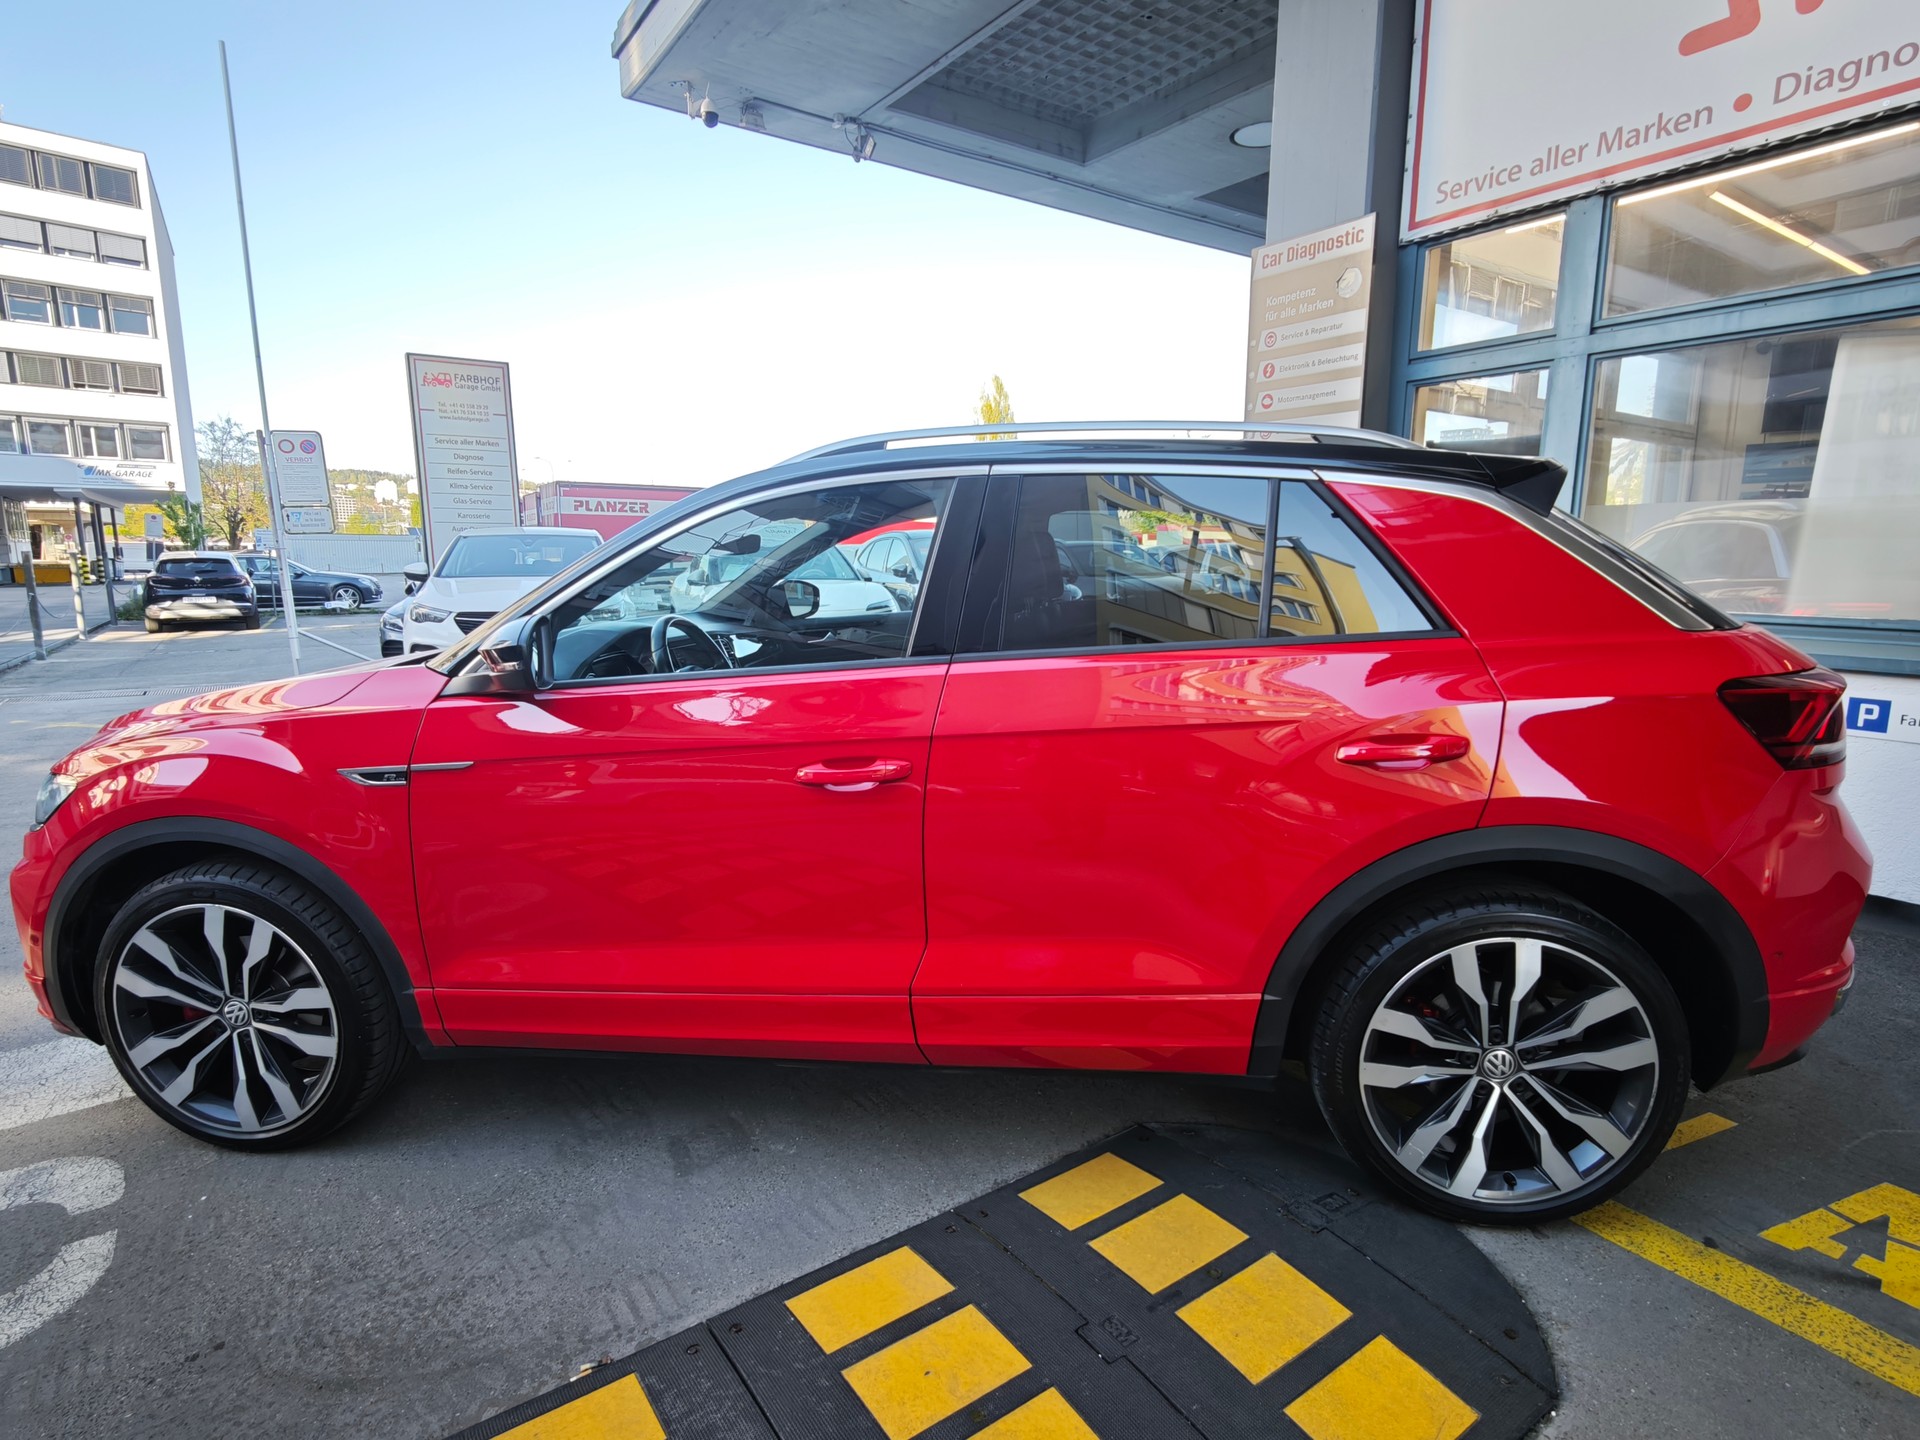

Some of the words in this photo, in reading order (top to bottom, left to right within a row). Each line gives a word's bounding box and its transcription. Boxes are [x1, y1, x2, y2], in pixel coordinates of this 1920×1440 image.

[1435, 163, 1522, 205] Service
[1530, 140, 1589, 177] aller
[1596, 105, 1714, 158] Marken
[1772, 41, 1920, 105] Diagno
[1261, 250, 1284, 270] Car
[1286, 227, 1365, 263] Diagnostic
[1265, 287, 1317, 308] Kompetenz
[1265, 310, 1278, 323] für
[1280, 306, 1297, 320] alle
[1299, 298, 1334, 315] Marken
[1280, 329, 1304, 341] Service
[1310, 322, 1343, 336] Reparatur
[1279, 360, 1311, 373] Elektronik
[1317, 352, 1359, 367] Beleuchtung
[454, 373, 500, 386] FARBHOF
[454, 382, 479, 391] Garage
[480, 384, 501, 392] GmbH
[1277, 389, 1336, 404] Motormanagement
[434, 437, 459, 446] Service
[460, 438, 474, 446] aller
[475, 439, 500, 447] Marken
[453, 453, 484, 462] Diagnose
[447, 467, 493, 477] Reifen-Service
[449, 482, 494, 491] Klima-Service
[453, 497, 493, 506] Glas-Service
[573, 499, 650, 514] PLANZER
[457, 512, 491, 520] Karosserie
